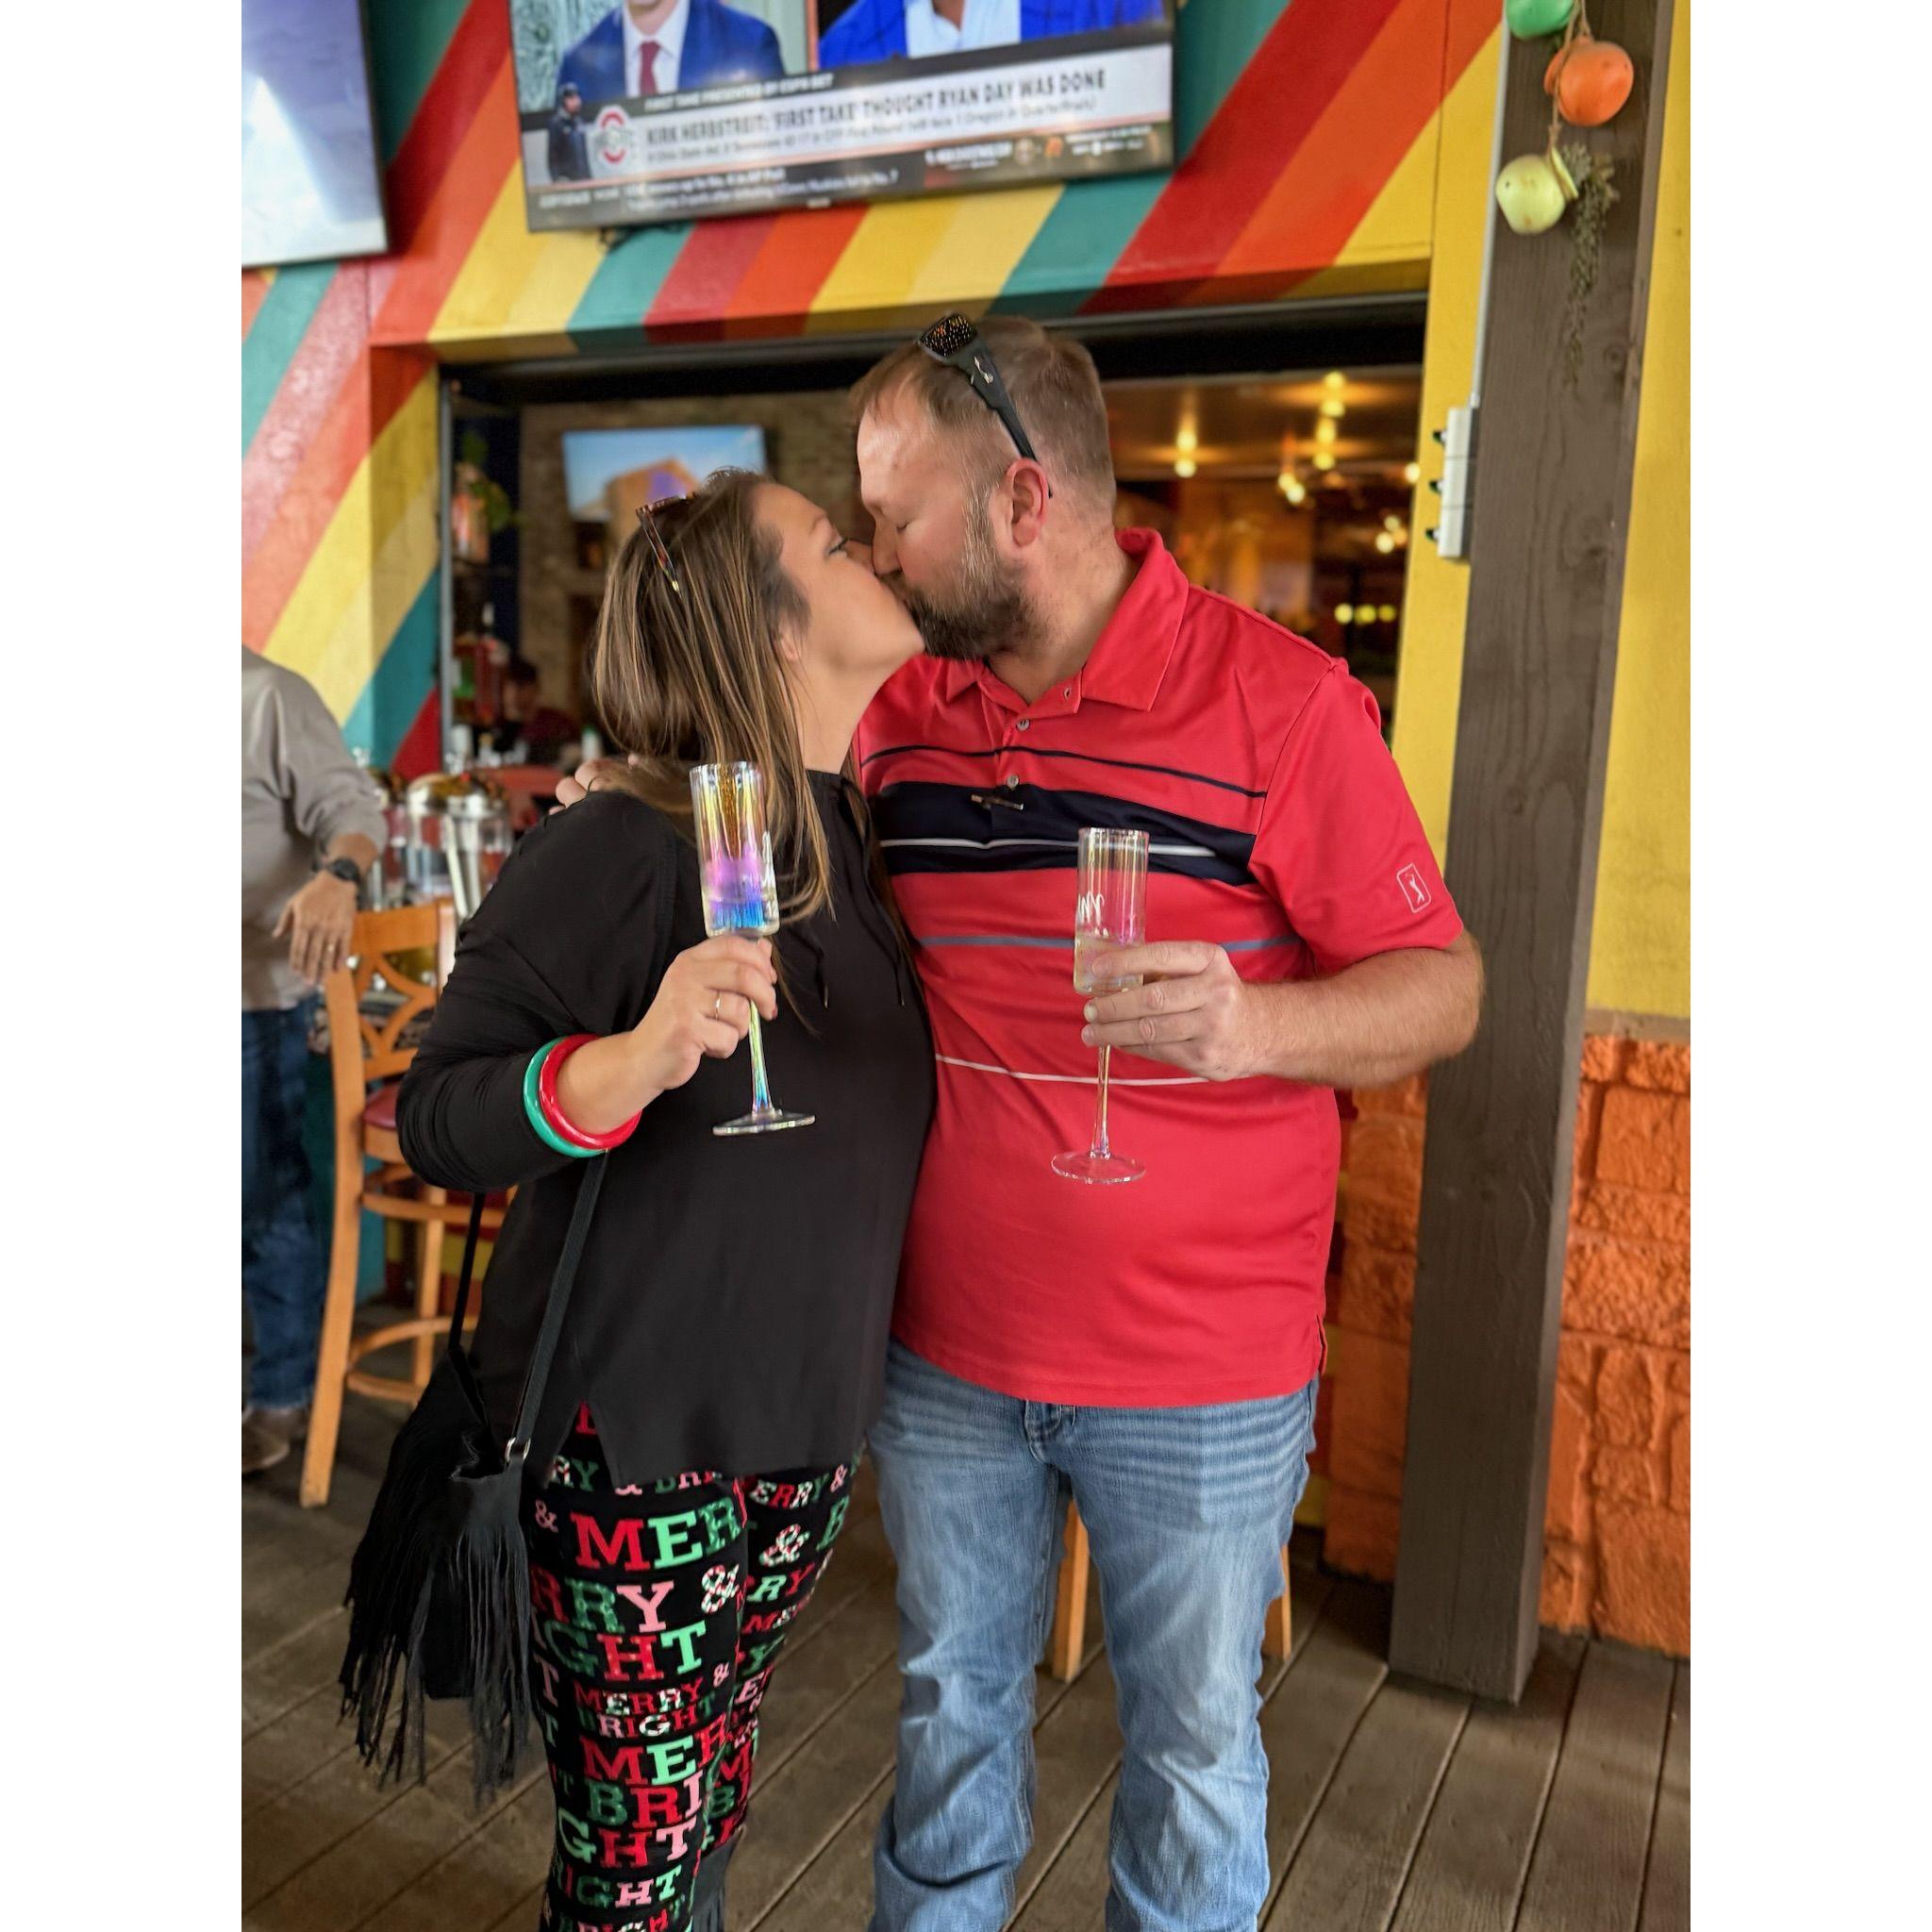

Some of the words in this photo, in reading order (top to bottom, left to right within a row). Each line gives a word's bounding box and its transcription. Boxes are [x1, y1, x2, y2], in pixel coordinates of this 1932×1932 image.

[863, 91, 933, 118] THOUGHT
[940, 87, 979, 107] RYAN
[984, 81, 1013, 104] DAY
[1020, 75, 1054, 97] WAS
[1061, 69, 1105, 93] DONE
[573, 1675, 704, 1716] MERRY
